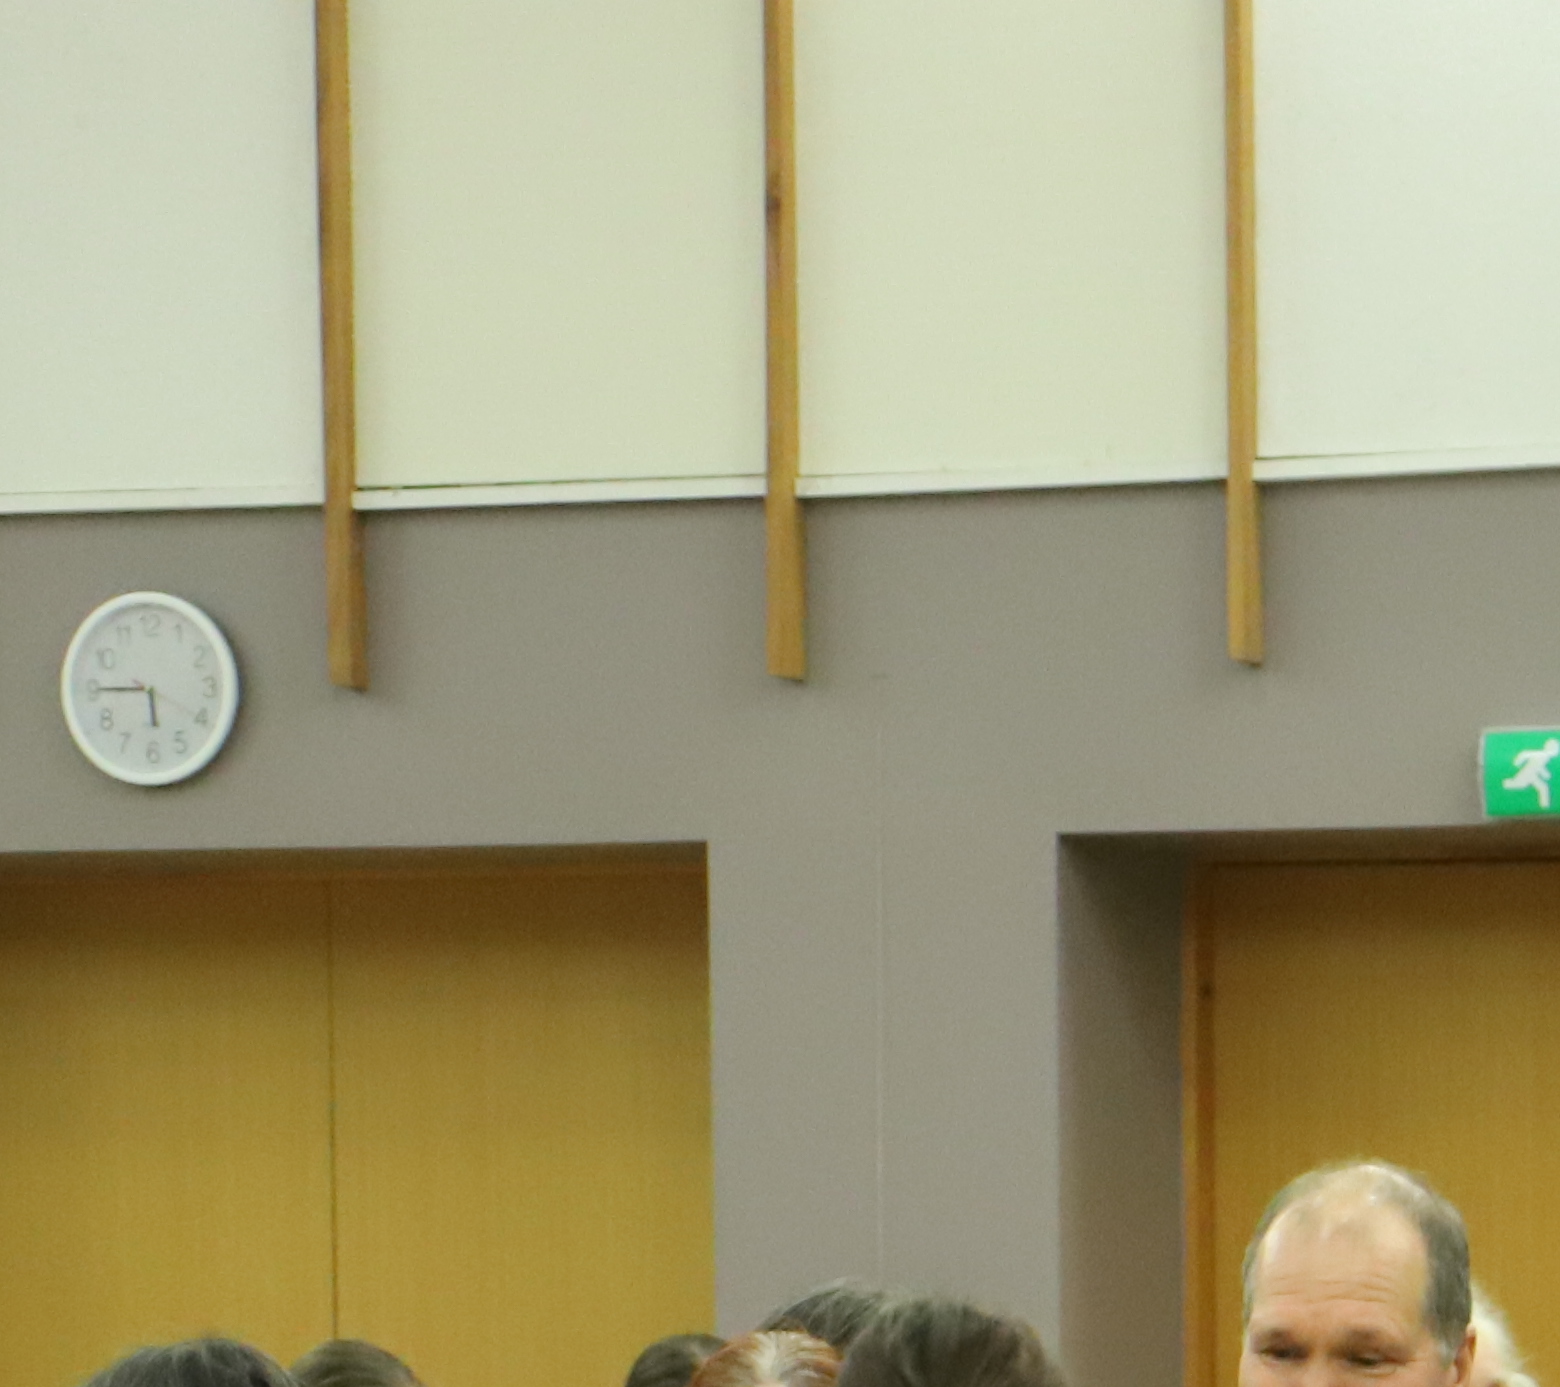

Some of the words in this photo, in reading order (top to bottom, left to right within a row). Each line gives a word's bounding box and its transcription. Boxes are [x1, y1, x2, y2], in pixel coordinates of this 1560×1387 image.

[139, 614, 162, 637] 12
[96, 648, 115, 670] 10
[193, 645, 208, 668] 2
[85, 679, 100, 701] 9
[202, 677, 217, 698] 3
[99, 708, 114, 730] 8
[193, 708, 209, 728] 4
[119, 732, 132, 754] 7
[145, 741, 160, 764] 6
[173, 731, 187, 754] 5
